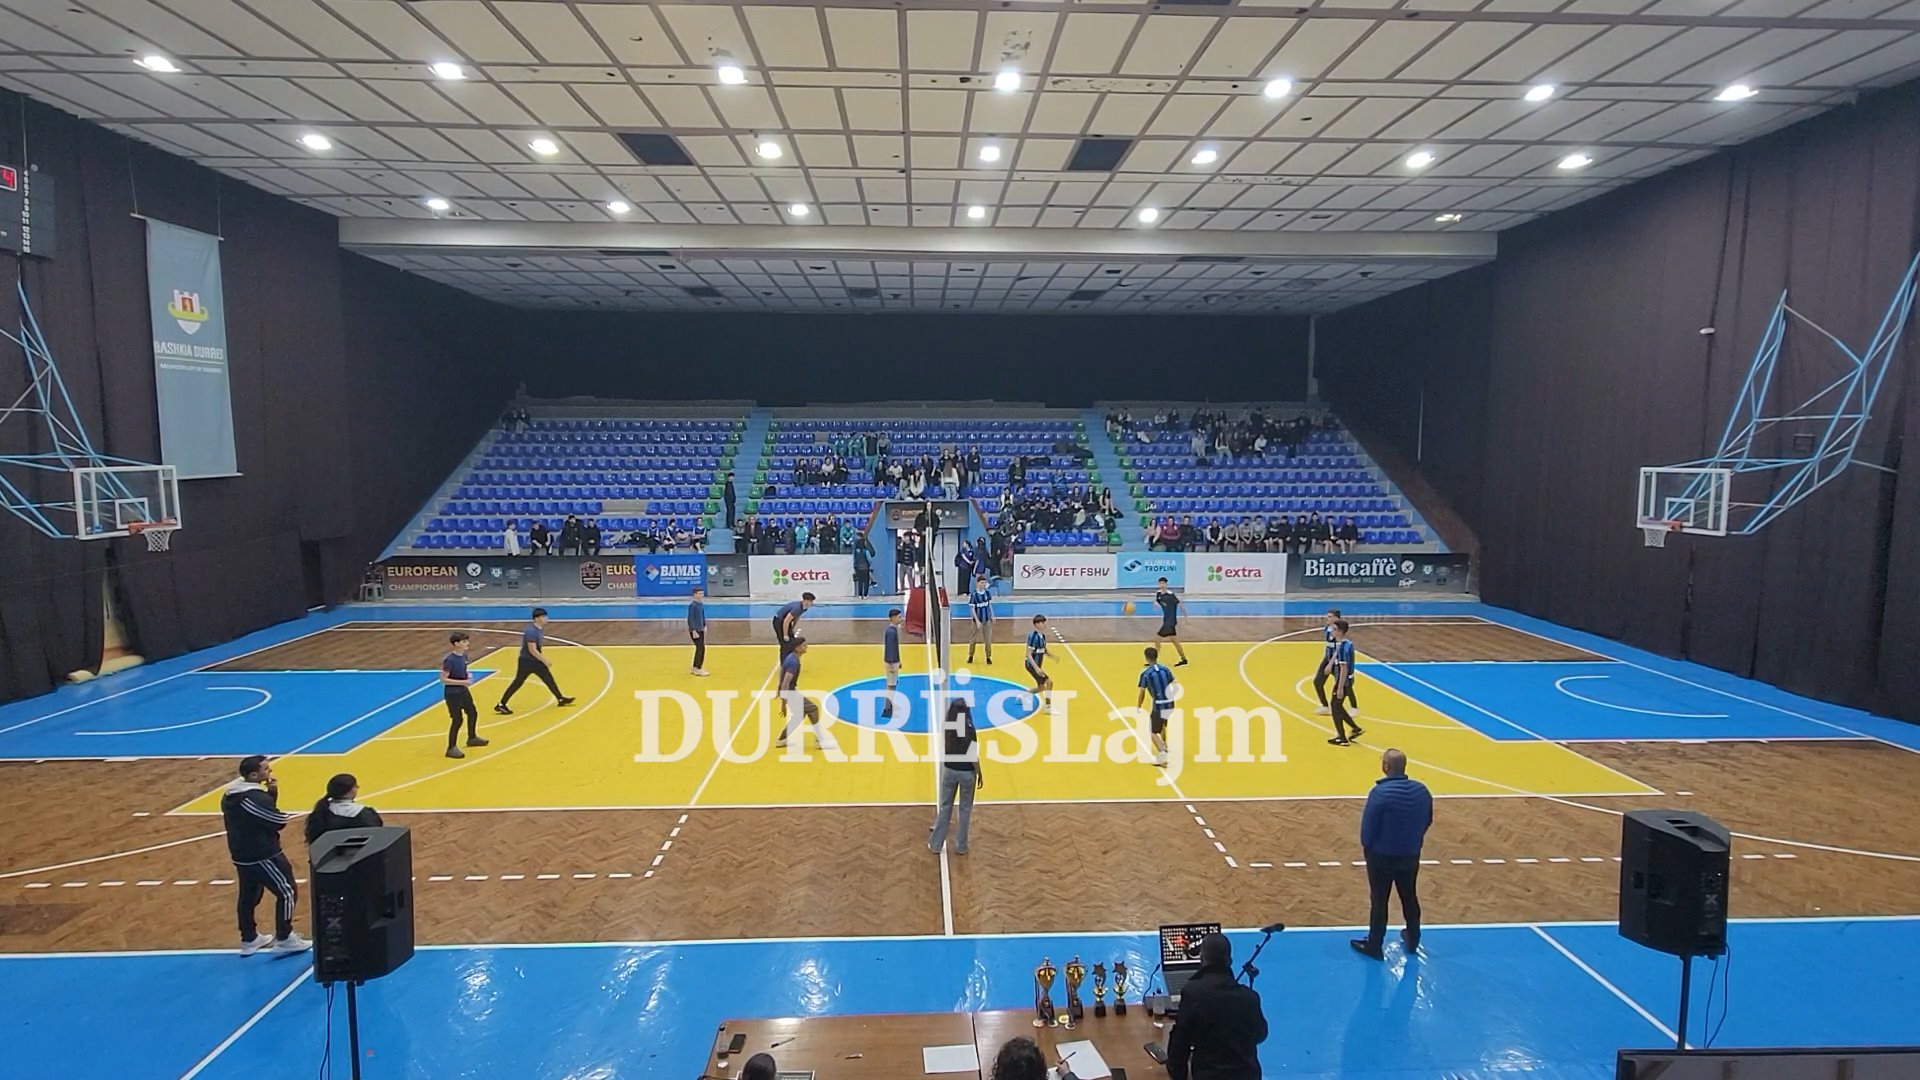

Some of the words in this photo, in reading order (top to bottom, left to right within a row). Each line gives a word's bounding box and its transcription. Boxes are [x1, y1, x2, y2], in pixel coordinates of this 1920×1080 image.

[387, 565, 459, 577] EUROPEAN
[660, 564, 701, 577] BAMAS
[1049, 567, 1077, 577] VJET
[1080, 567, 1110, 577] FSHV
[1224, 565, 1262, 578] extra
[1304, 557, 1397, 577] Biancaffè
[791, 568, 830, 581] extra
[388, 583, 460, 592] CHAMPIONSHIPS
